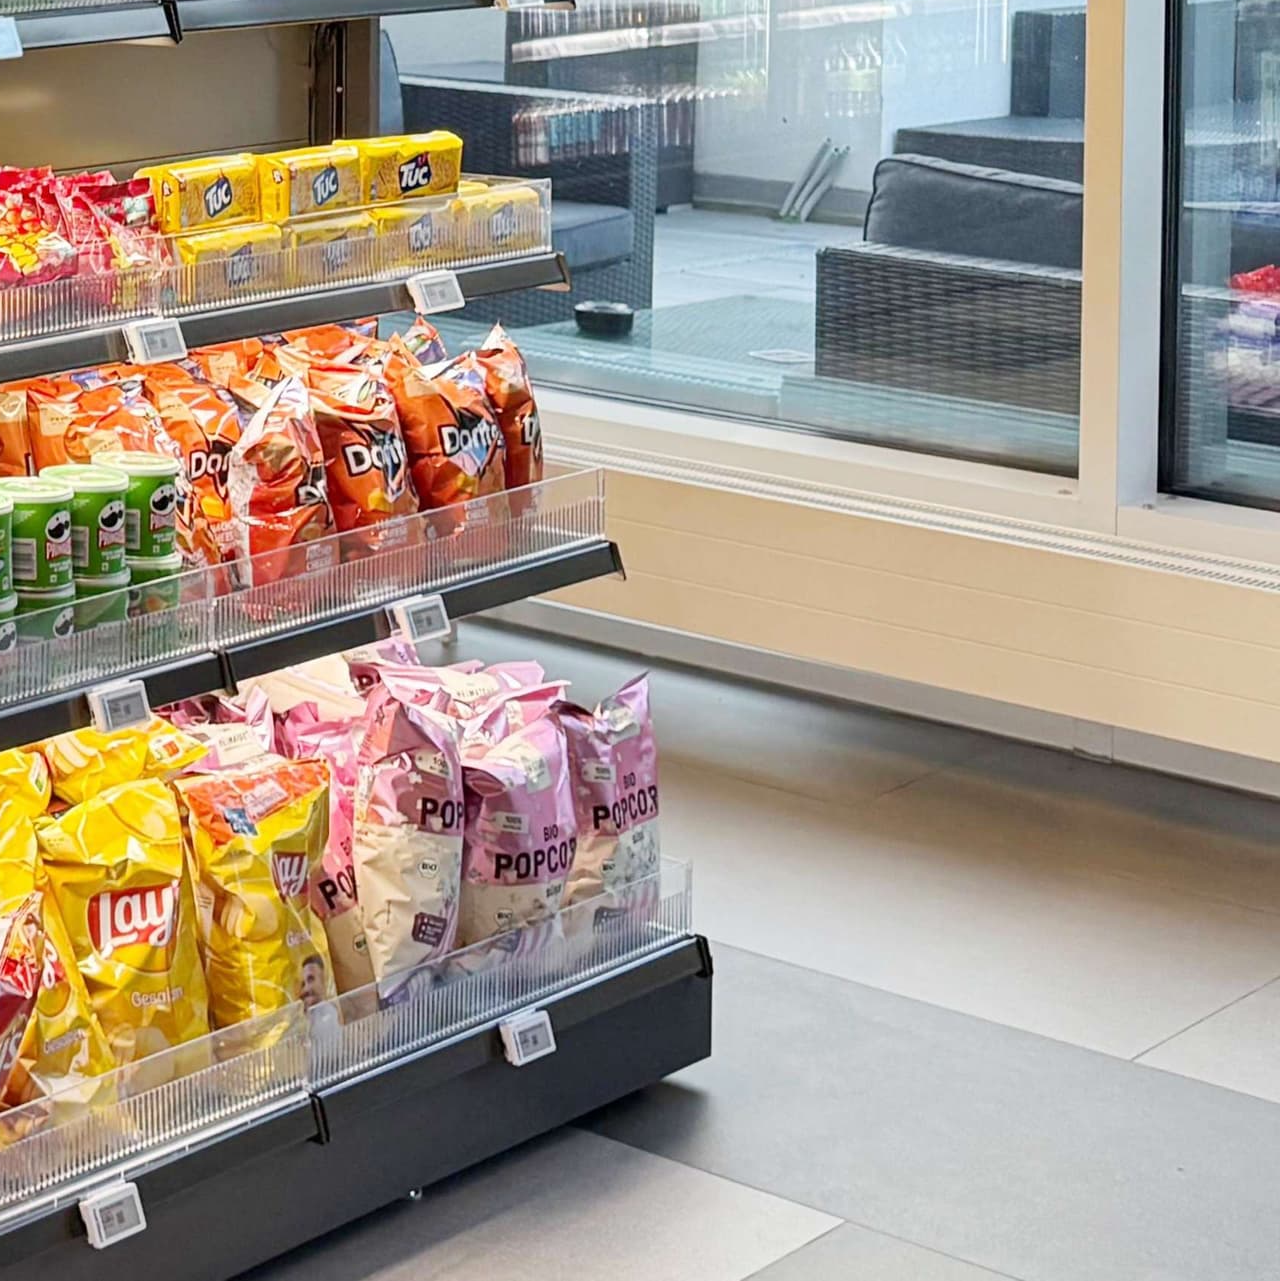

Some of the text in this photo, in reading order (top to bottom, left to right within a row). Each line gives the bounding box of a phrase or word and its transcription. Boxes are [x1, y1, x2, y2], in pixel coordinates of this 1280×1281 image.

[313, 170, 338, 206] TUC
[400, 162, 430, 188] TUC
[205, 179, 231, 217] TUC
[623, 772, 636, 789] BIO
[543, 823, 559, 842] BIO
